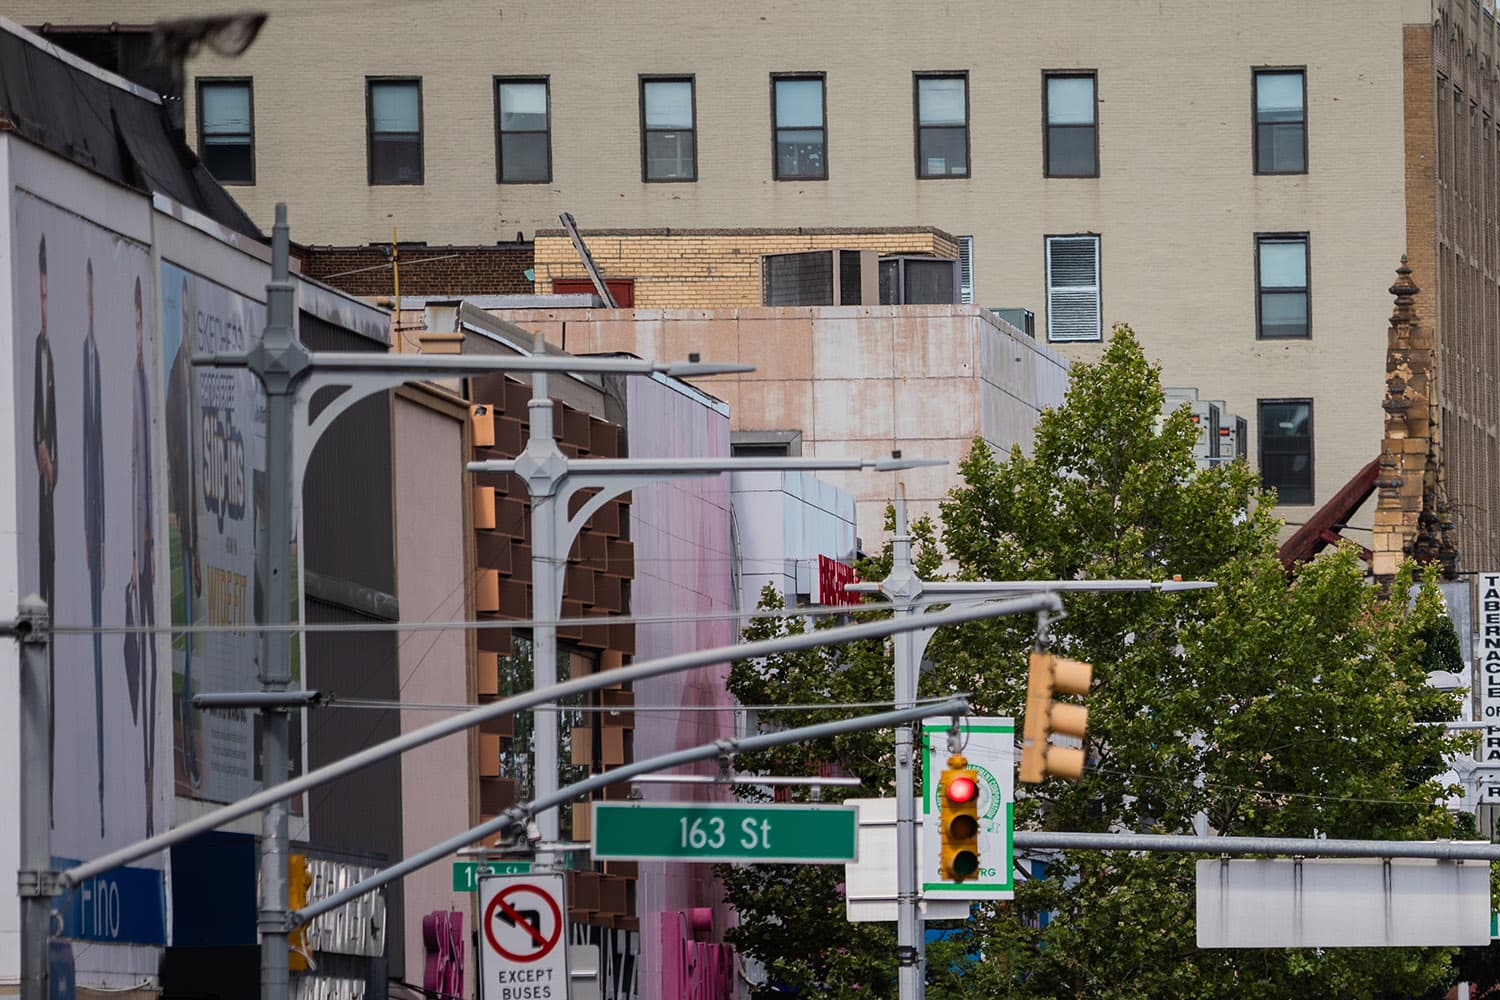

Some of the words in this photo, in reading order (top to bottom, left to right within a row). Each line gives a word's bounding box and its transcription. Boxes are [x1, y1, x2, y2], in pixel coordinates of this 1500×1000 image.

[679, 817, 726, 849] 163
[741, 817, 772, 849] St
[499, 969, 553, 984] EXCEPT
[502, 986, 551, 1000] BUSES
